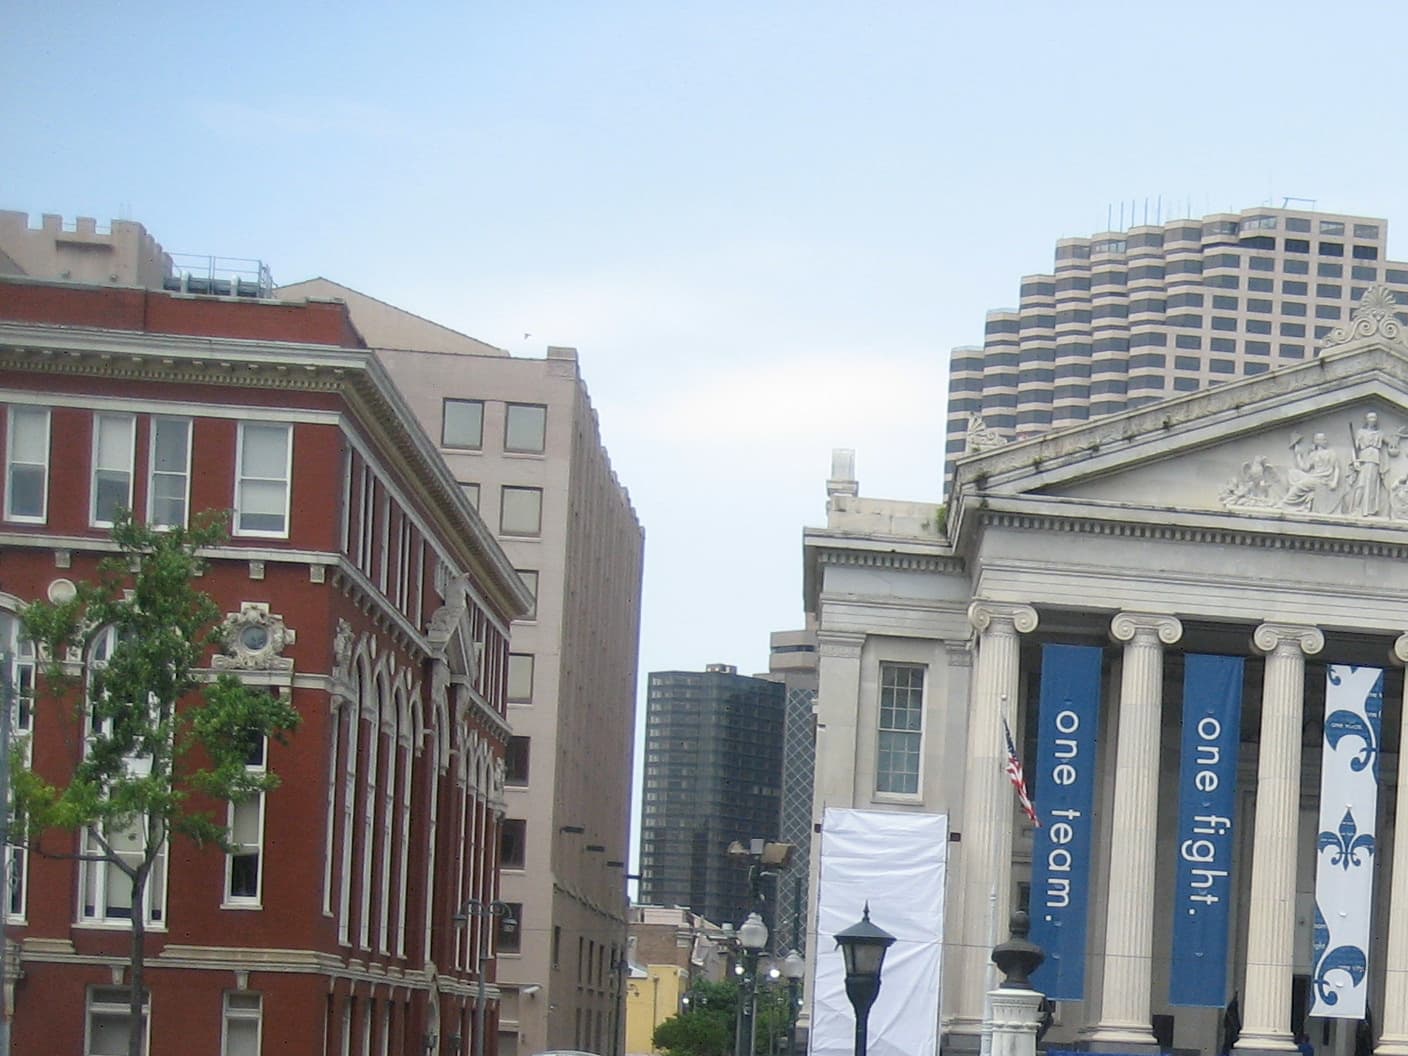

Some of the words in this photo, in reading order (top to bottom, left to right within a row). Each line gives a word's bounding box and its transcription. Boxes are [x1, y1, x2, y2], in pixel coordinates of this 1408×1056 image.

[1053, 710, 1079, 785] one
[1195, 717, 1221, 792] one
[1045, 809, 1081, 921] team.
[1181, 815, 1231, 915] fight.
